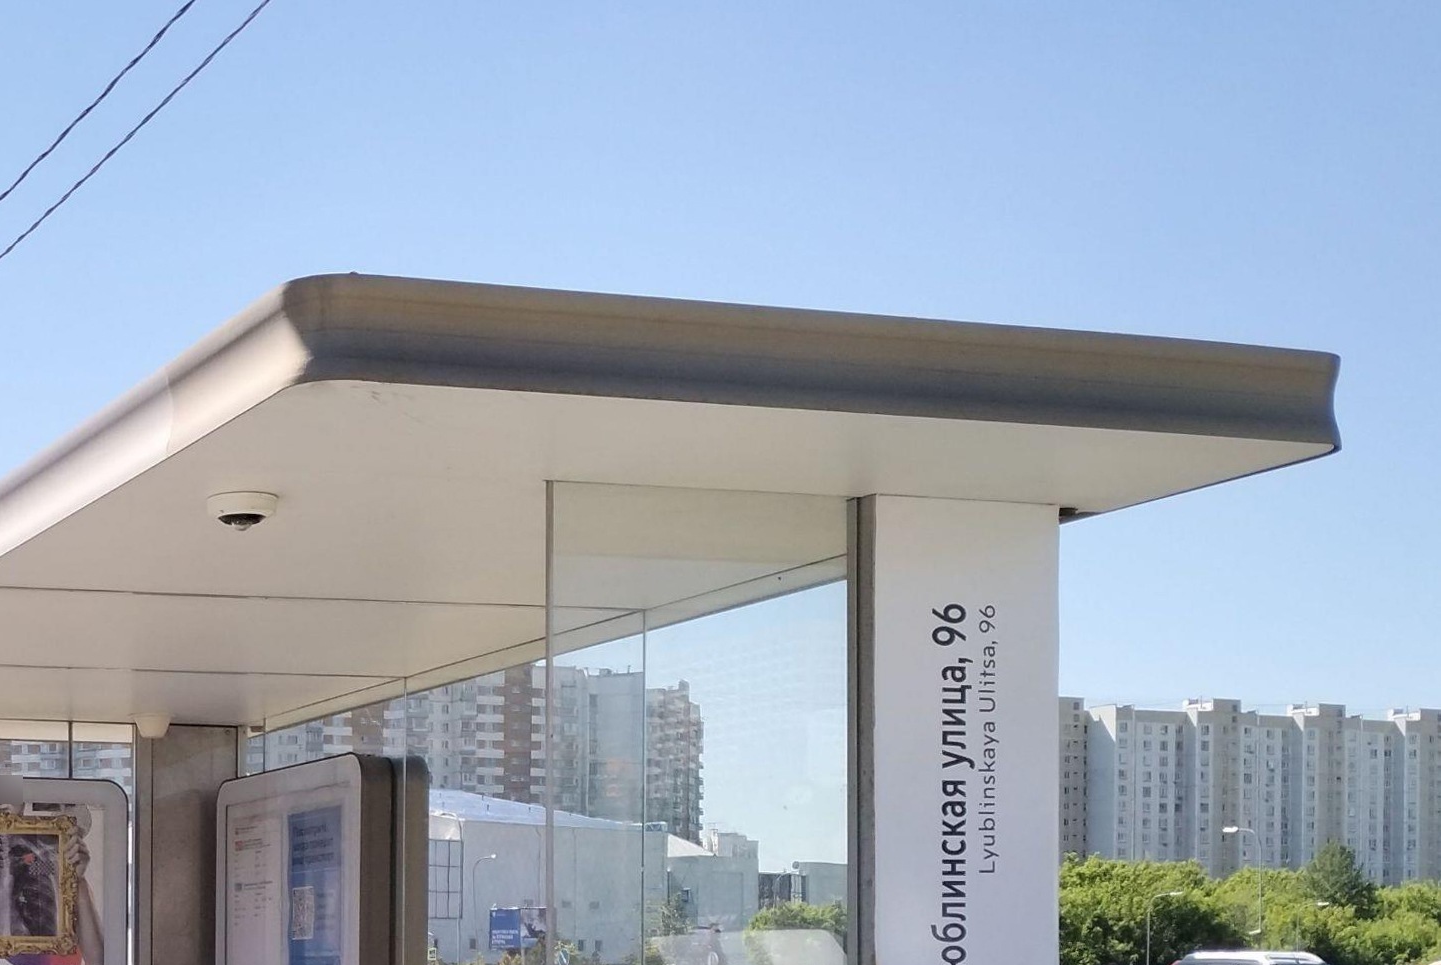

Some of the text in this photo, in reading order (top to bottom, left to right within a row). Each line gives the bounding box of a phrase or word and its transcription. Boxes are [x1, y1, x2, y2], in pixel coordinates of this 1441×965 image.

[931, 602, 968, 647] 96
[940, 656, 975, 771] улица,
[978, 604, 1000, 874] Lyublinskaya Ulitsa, 96
